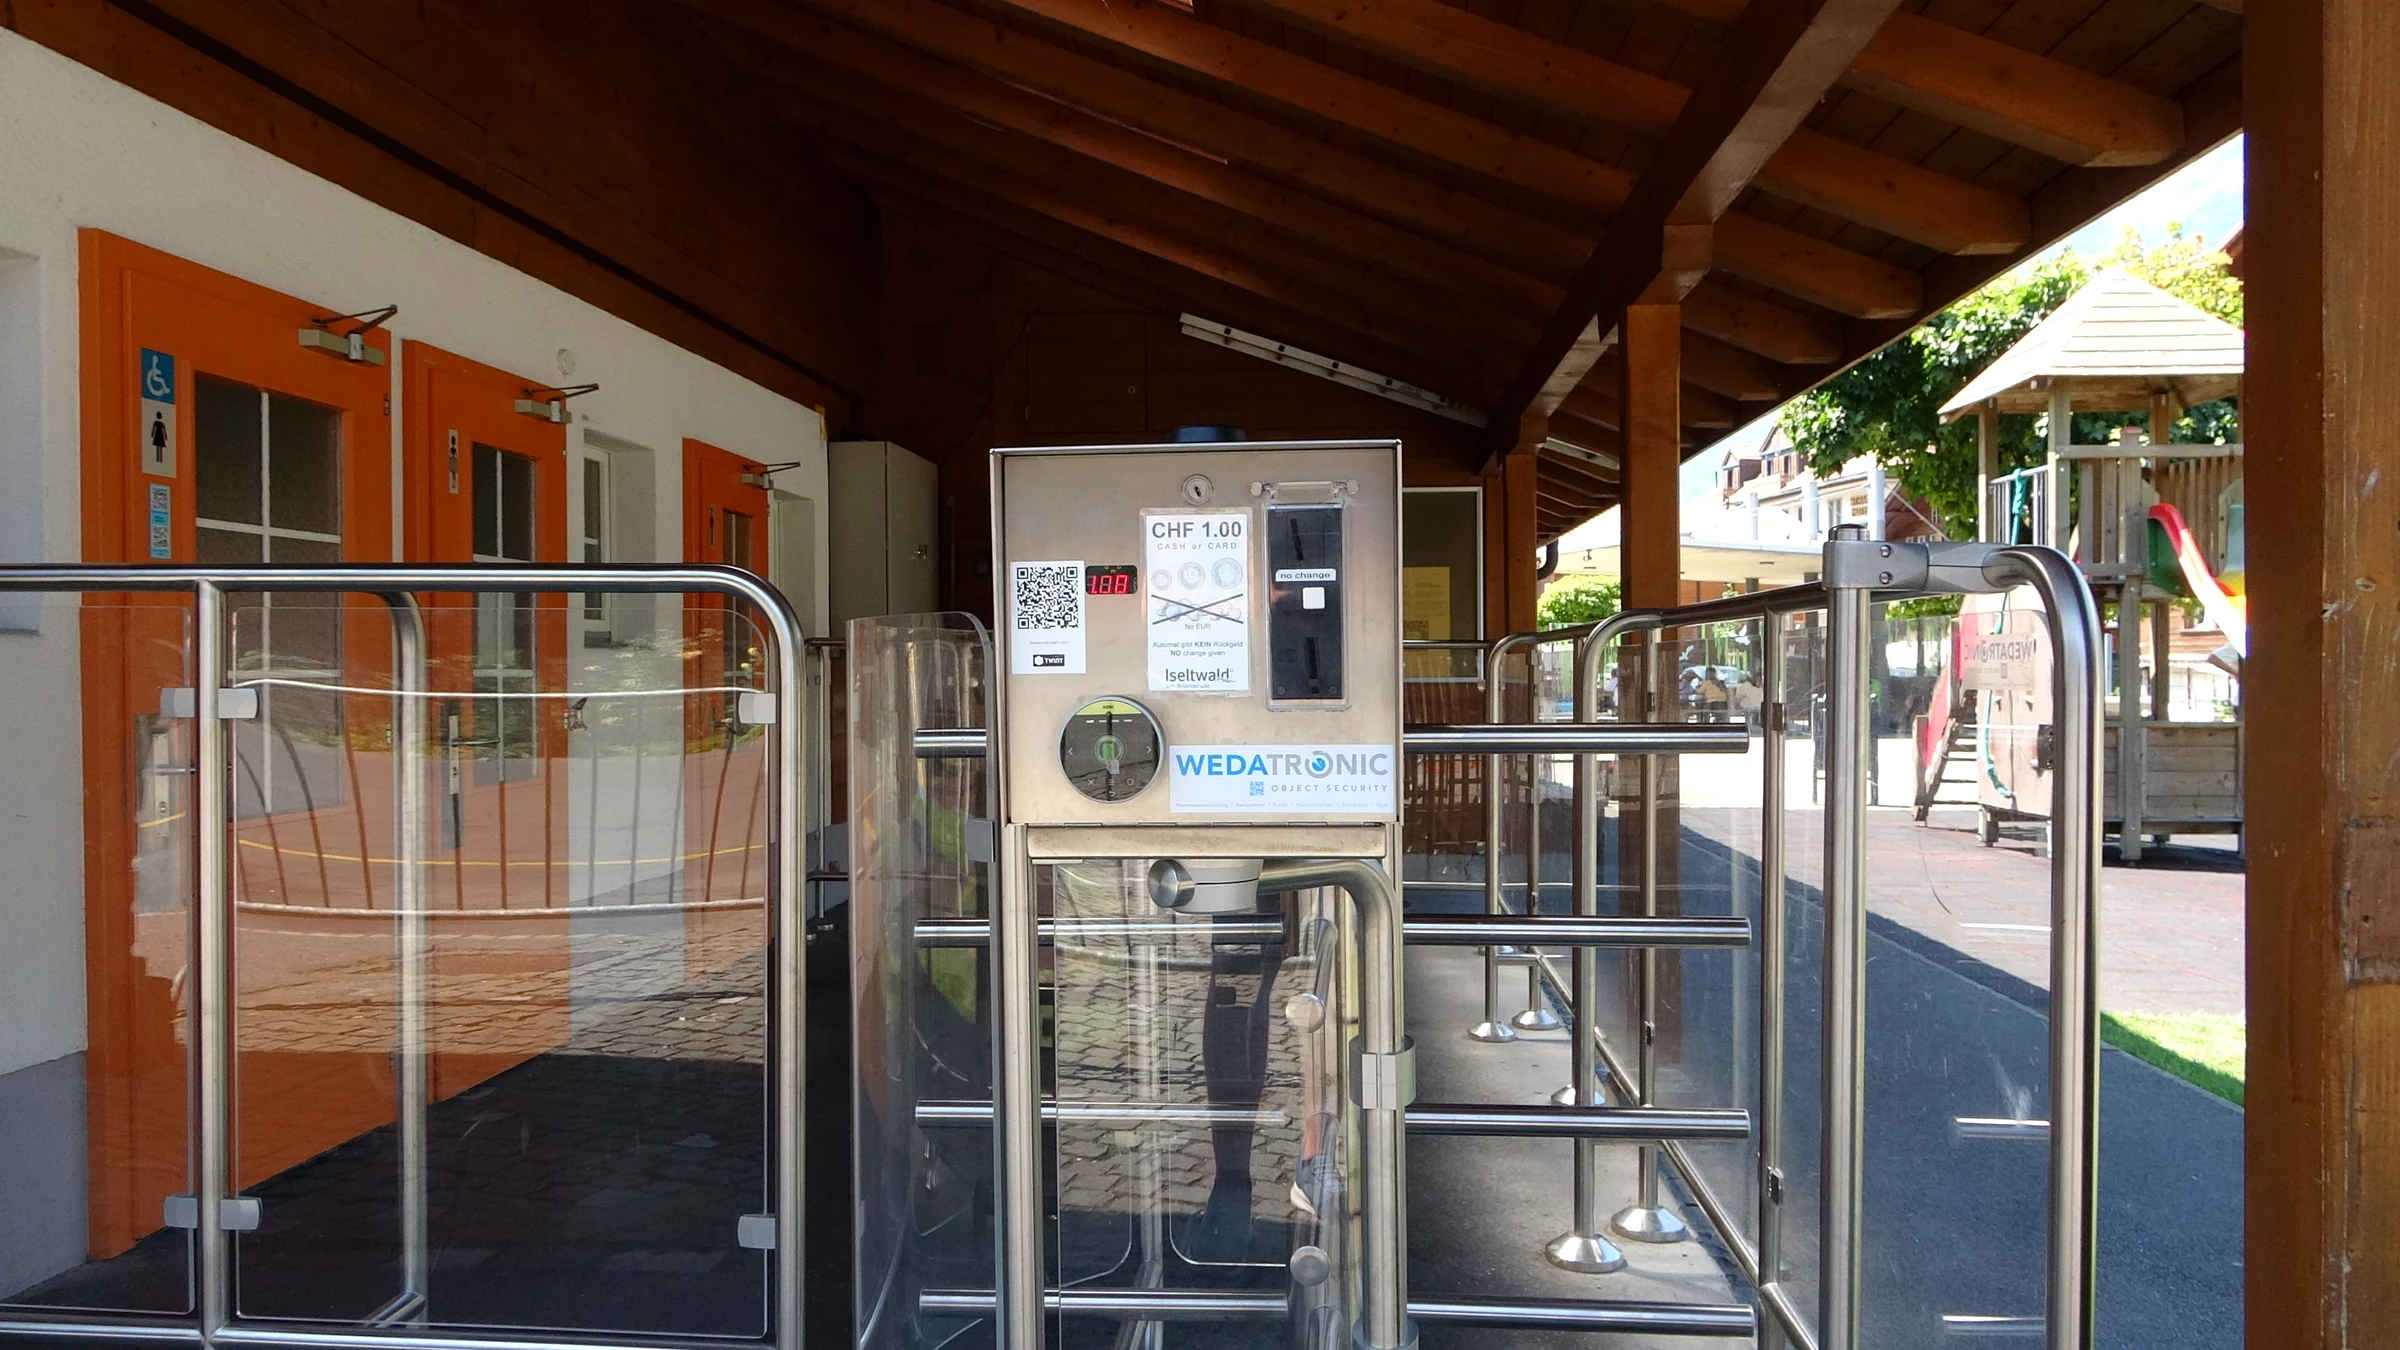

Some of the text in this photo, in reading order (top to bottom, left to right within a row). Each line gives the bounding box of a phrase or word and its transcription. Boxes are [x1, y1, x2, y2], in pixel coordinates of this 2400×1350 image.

[1152, 521, 1242, 538] CHF 1.00
[1208, 542, 1237, 550] CARD
[1295, 571, 1330, 579] change
[1091, 574, 1128, 594] 1.00
[1181, 641, 1193, 649] gibt
[1213, 641, 1243, 649] Rückgeld
[1165, 668, 1229, 682] Iseltwald
[1176, 750, 1388, 779] WEDATRONIC
[1271, 784, 1388, 792] OBJECT SECURITY
